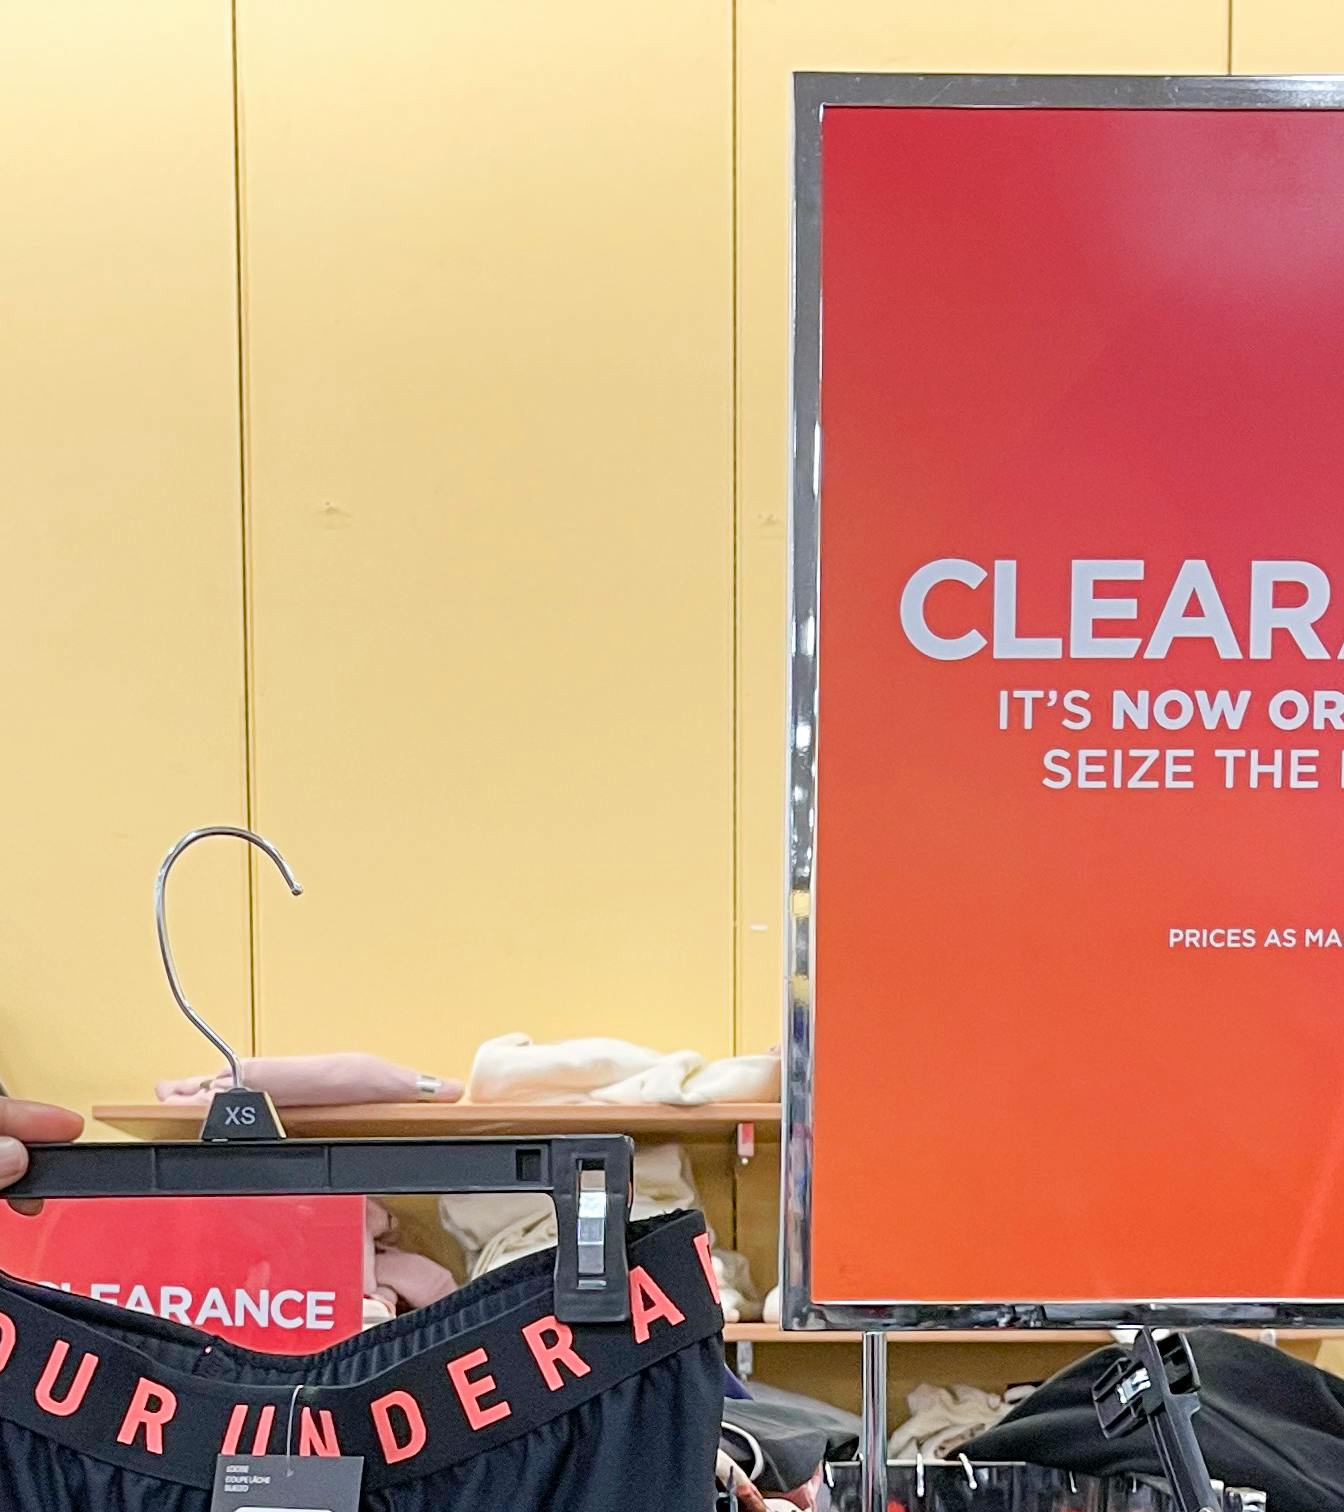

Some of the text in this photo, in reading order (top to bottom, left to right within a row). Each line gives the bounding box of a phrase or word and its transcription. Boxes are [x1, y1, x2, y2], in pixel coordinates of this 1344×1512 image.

[998, 690, 1091, 731] IT’S
[1112, 690, 1251, 732] NOW
[1042, 748, 1194, 790] SEIZE
[1215, 749, 1320, 790] THE
[1169, 928, 1258, 949] PRICES
[1264, 929, 1298, 948] AS
[224, 1106, 256, 1126] XS
[36, 1280, 335, 1330] EARANCE
[221, 1315, 591, 1466] UNDER
